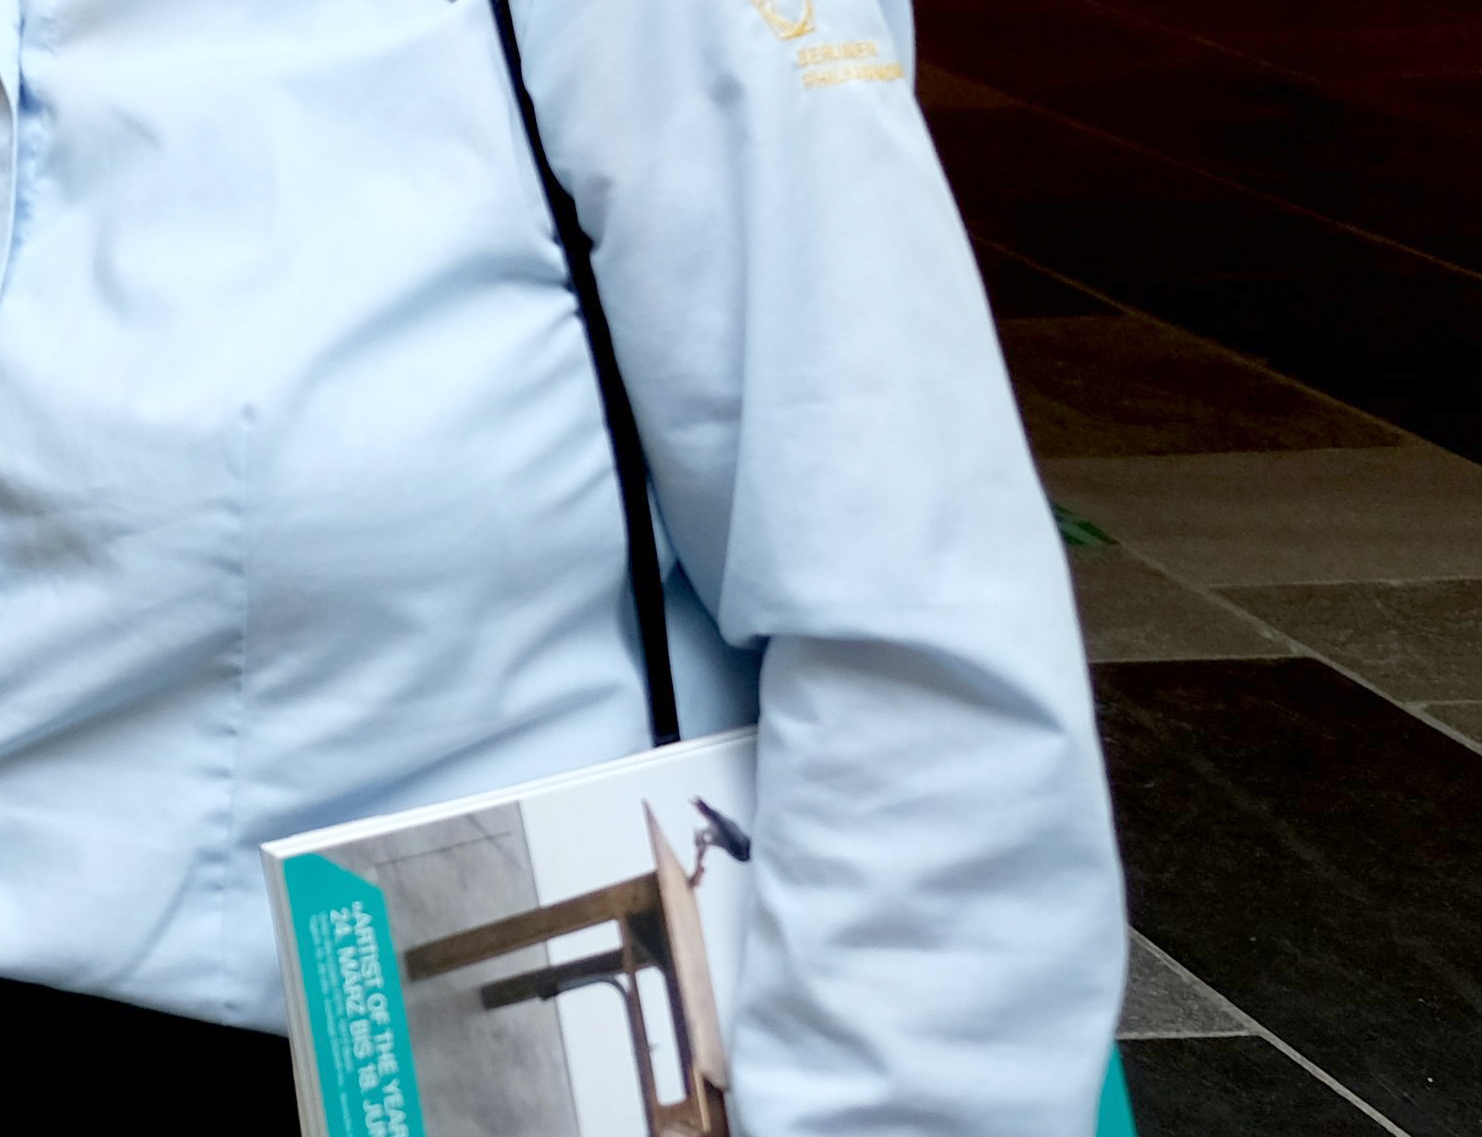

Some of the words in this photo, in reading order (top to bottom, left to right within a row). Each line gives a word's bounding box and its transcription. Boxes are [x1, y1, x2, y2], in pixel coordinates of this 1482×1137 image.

[367, 992, 391, 1026] OF
[350, 1019, 374, 1059] BIS
[374, 1029, 399, 1078] THE
